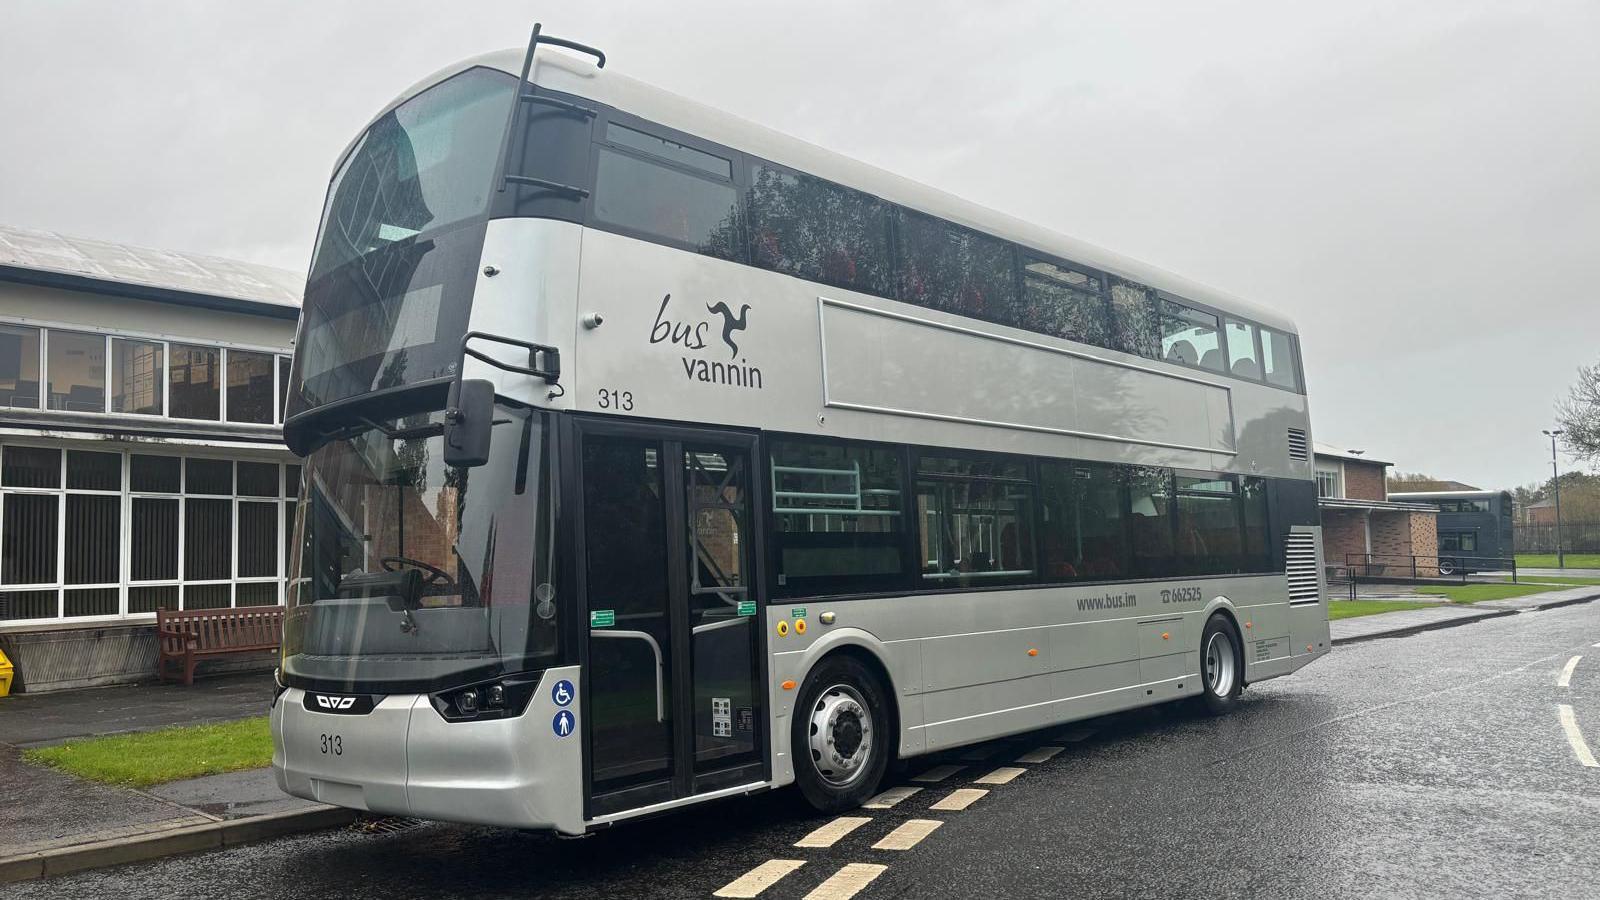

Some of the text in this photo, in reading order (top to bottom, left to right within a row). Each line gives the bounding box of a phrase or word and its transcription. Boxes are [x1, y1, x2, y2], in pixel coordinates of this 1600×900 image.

[650, 293, 709, 350] bus
[682, 357, 762, 389] vannin
[598, 388, 634, 411] 313
[1077, 592, 1137, 611] www.bus.im
[1172, 587, 1202, 603] 662525
[320, 733, 343, 756] 313
